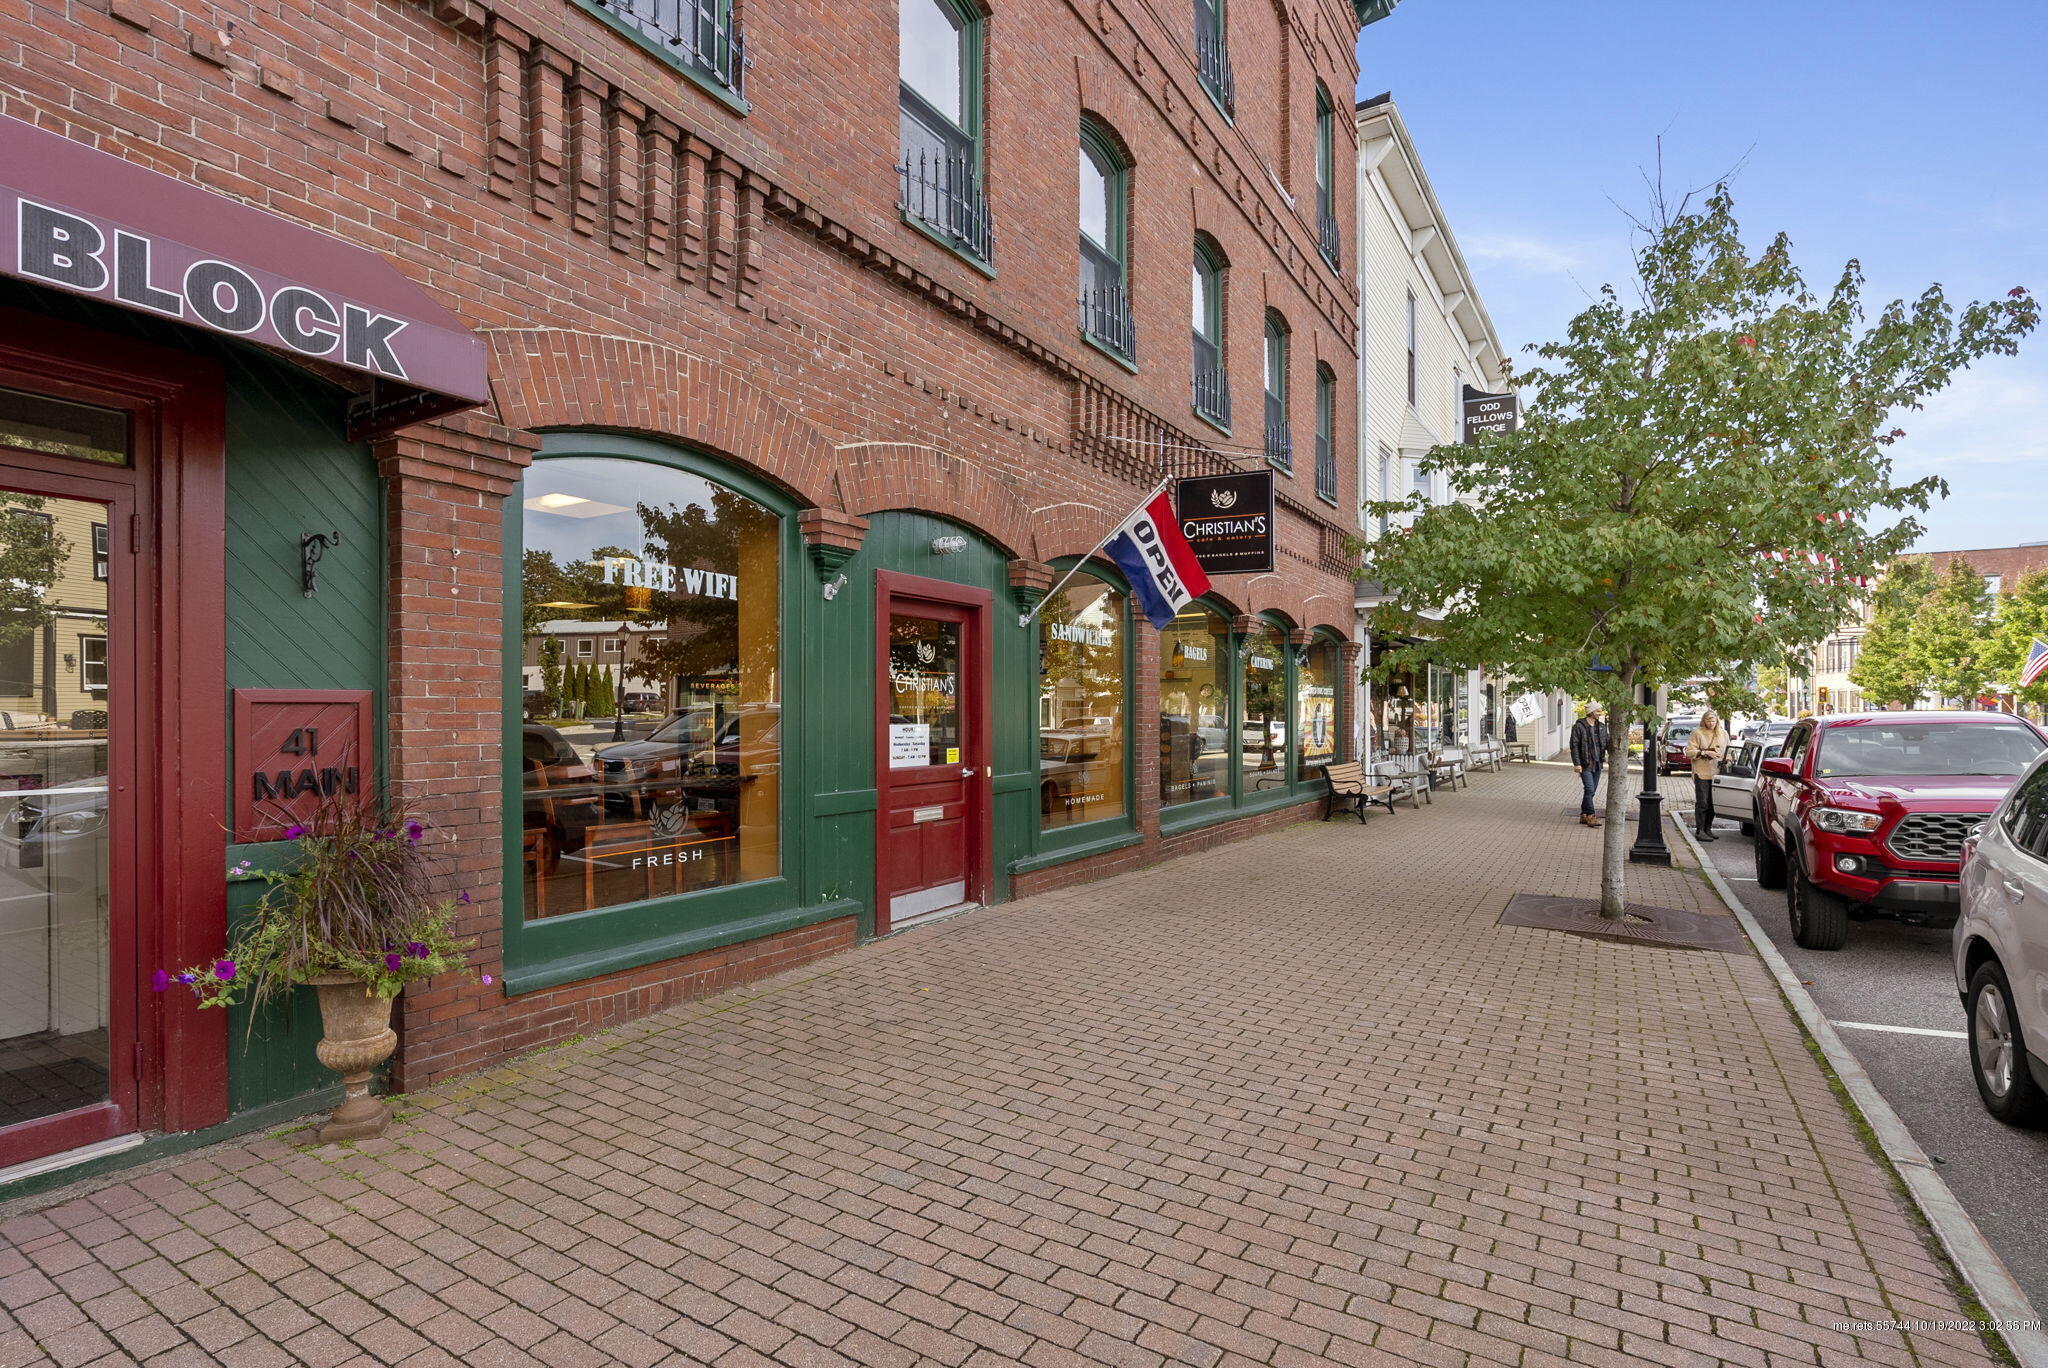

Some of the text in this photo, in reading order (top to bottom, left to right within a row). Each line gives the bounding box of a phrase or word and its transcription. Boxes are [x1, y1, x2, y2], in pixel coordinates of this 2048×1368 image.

[18, 197, 409, 381] BLOCK
[1480, 402, 1500, 412] ODD
[1467, 411, 1513, 424] FELLOWS
[1133, 520, 1184, 604] OPEN
[602, 556, 738, 600] FREE WIFI
[1184, 645, 1208, 661] BAGELS
[1250, 655, 1274, 671] CATERING
[281, 728, 319, 757] 41
[254, 767, 358, 800] MAIN
[1171, 782, 1192, 791] BAGELS
[1065, 794, 1105, 806] HOMEMADE
[632, 849, 702, 870] FRESH
